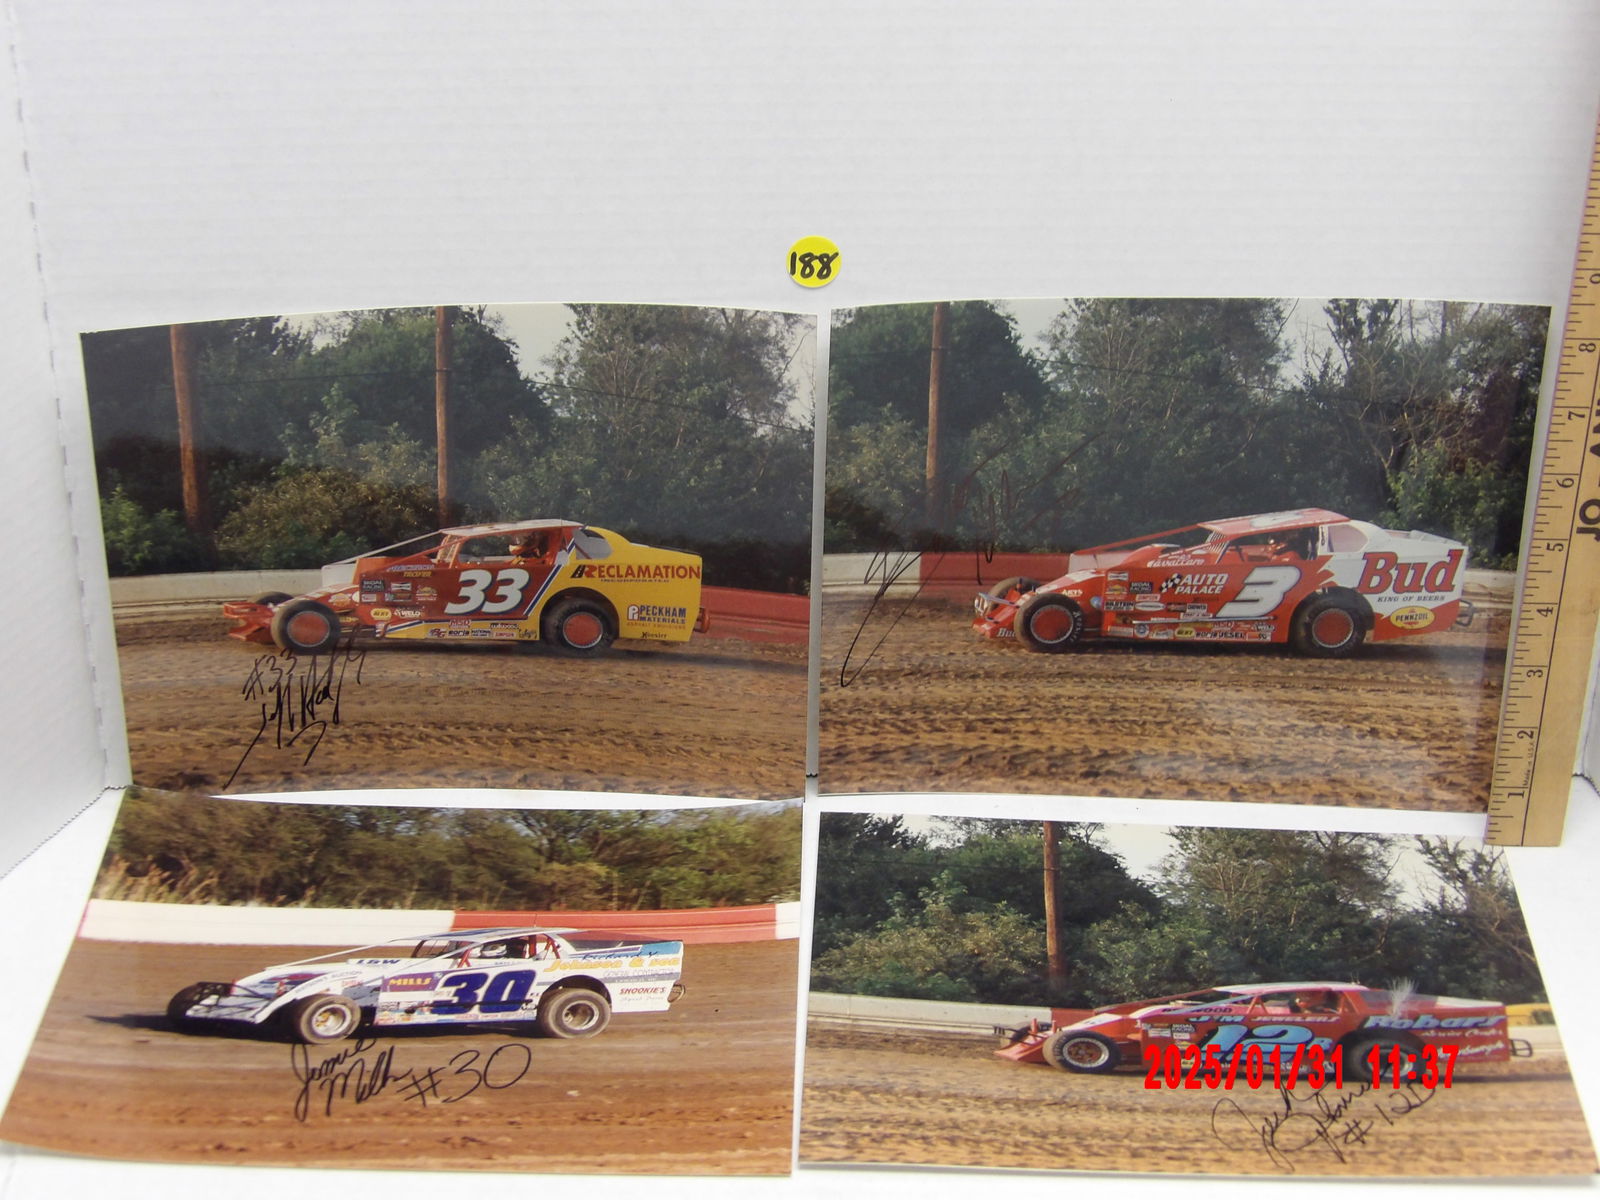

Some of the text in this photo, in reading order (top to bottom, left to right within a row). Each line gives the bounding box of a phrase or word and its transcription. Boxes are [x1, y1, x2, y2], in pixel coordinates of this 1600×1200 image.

[789, 251, 839, 280] 188
[1578, 342, 1597, 353] 8
[1567, 410, 1586, 421] 7
[1556, 477, 1575, 489] 6
[1546, 542, 1564, 552] 5
[1356, 549, 1464, 595] Bud
[1179, 574, 1229, 585] AUTO
[443, 568, 530, 615] 33
[1174, 585, 1224, 595] PALACE
[1216, 566, 1301, 617] 3
[401, 609, 421, 617] WELD
[639, 605, 687, 618] PECKHAM
[1537, 606, 1554, 618] 4
[639, 616, 687, 625] MATERIALS
[1395, 613, 1429, 622] PENNZOIL
[1526, 668, 1544, 679] 3
[1516, 730, 1534, 740] 2
[1507, 789, 1525, 799] 1
[430, 969, 537, 1015] 30
[396, 1043, 532, 1108] #30
